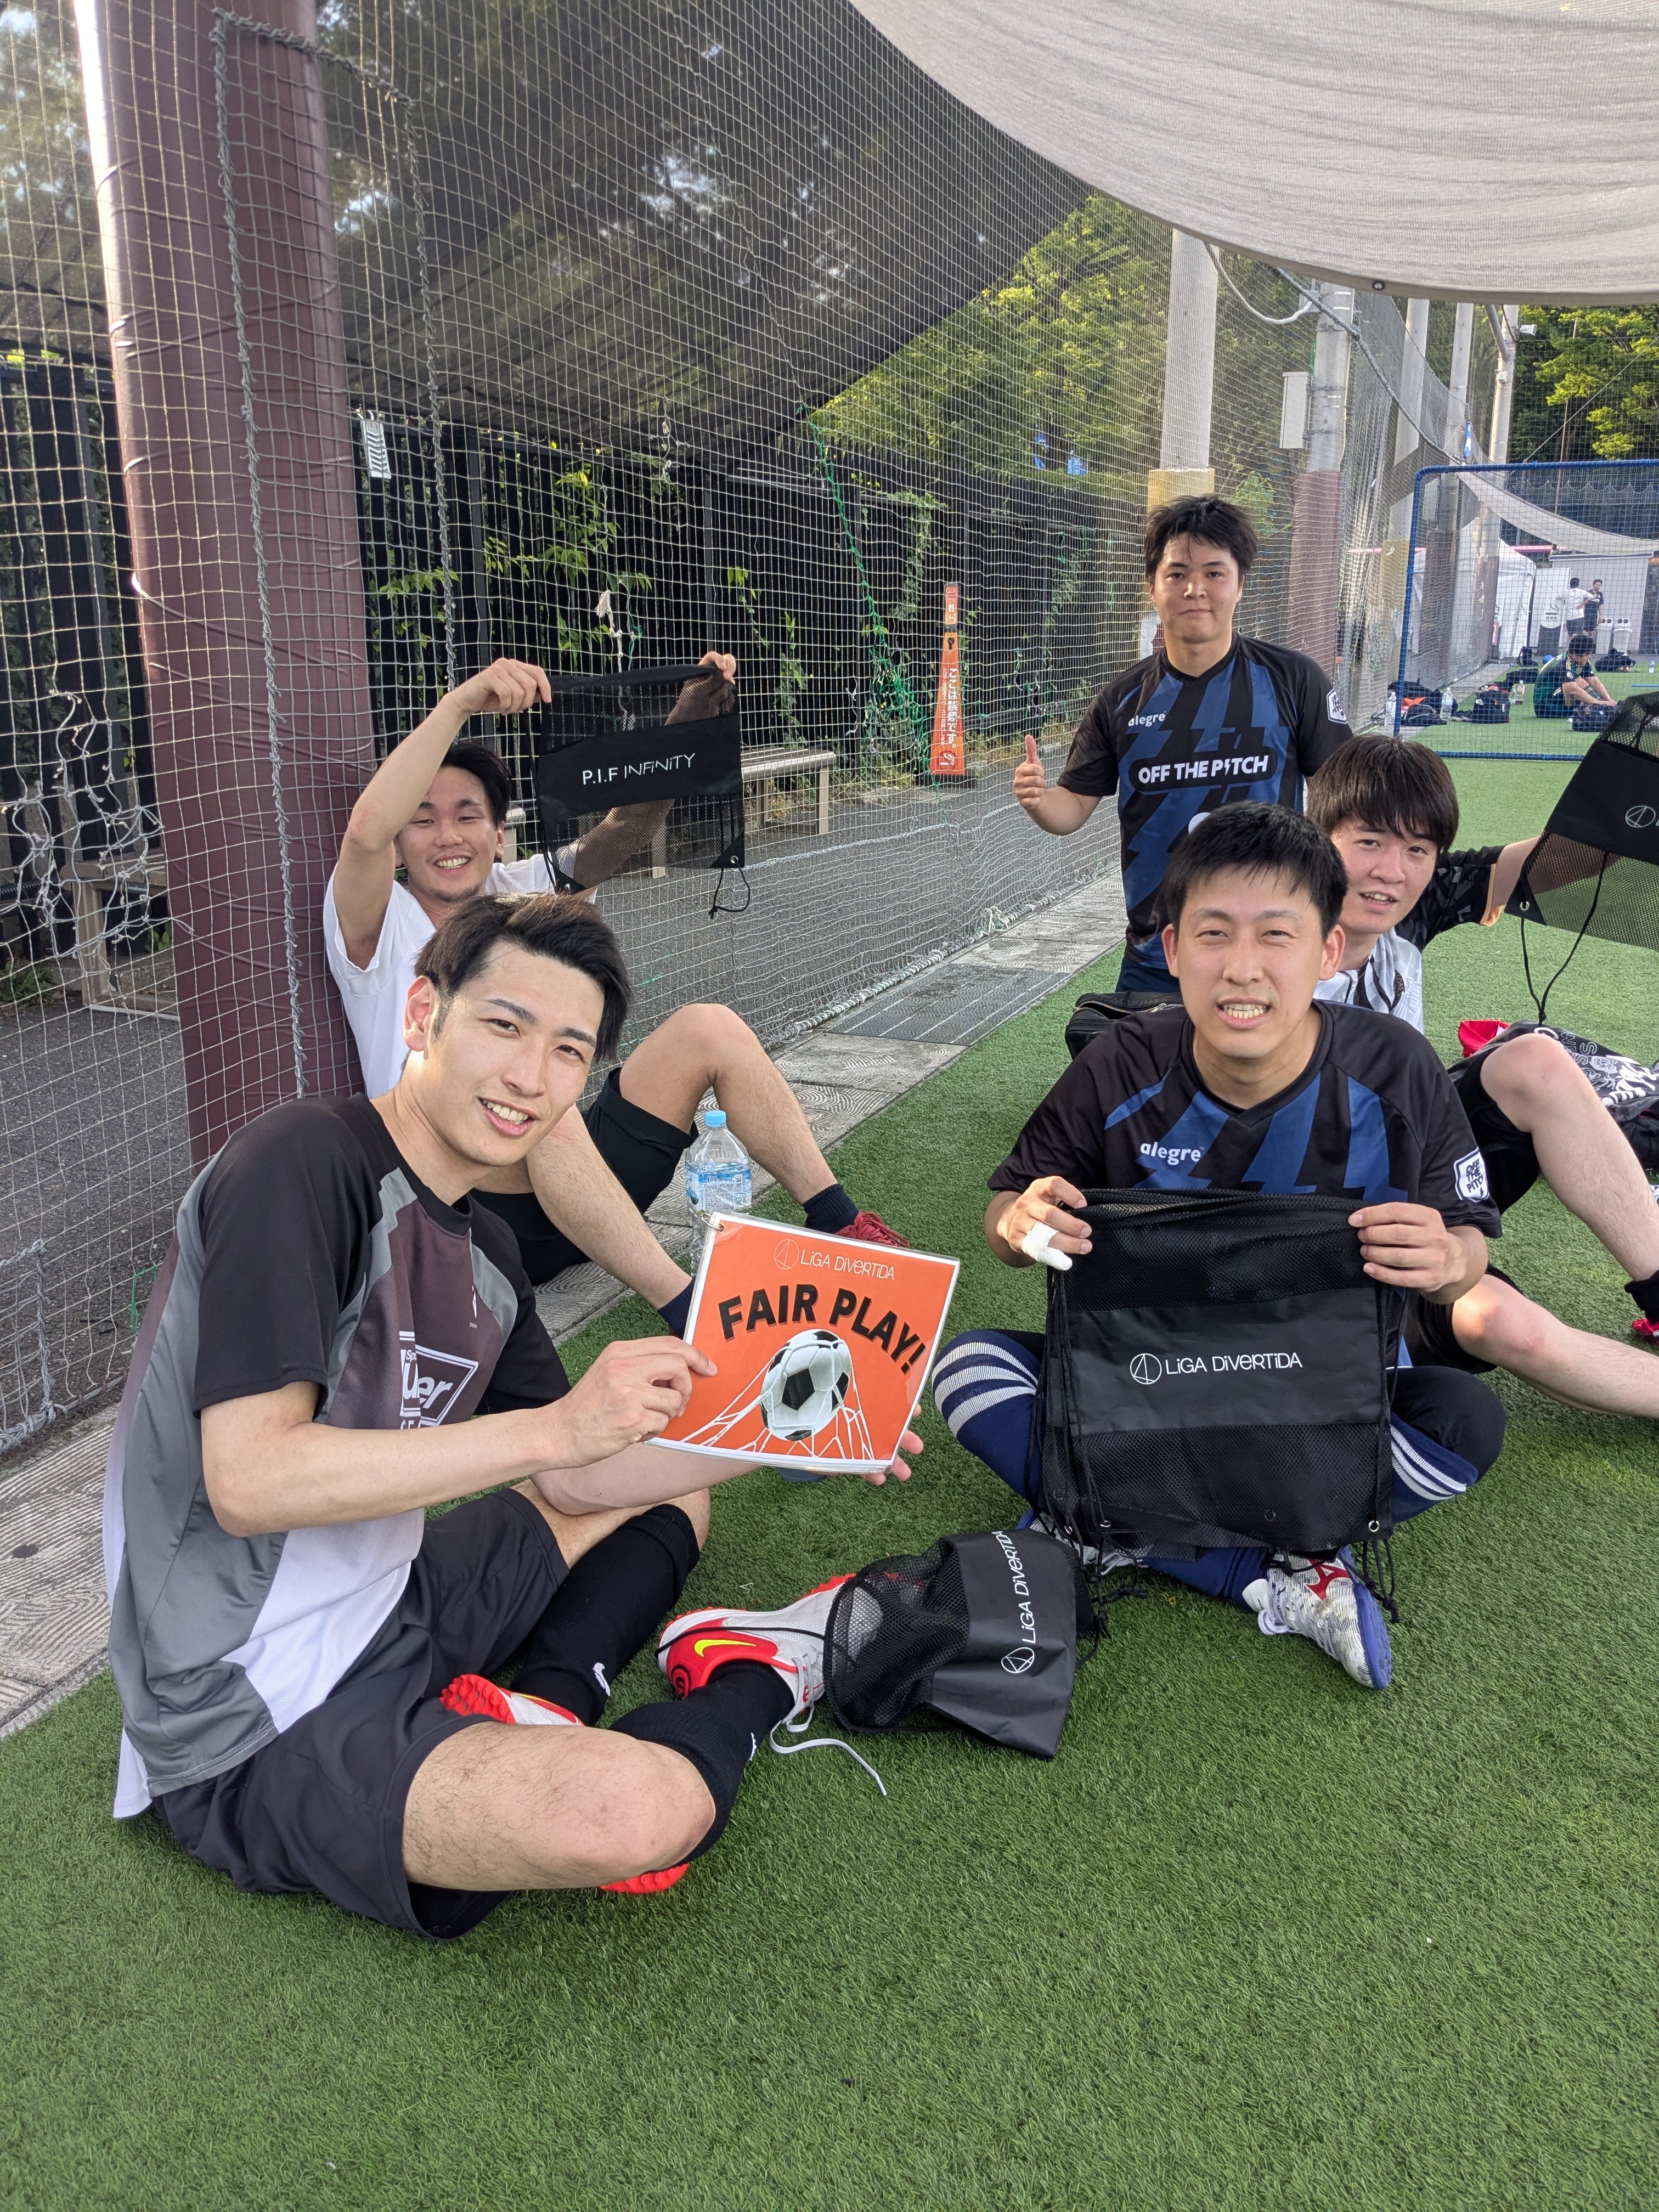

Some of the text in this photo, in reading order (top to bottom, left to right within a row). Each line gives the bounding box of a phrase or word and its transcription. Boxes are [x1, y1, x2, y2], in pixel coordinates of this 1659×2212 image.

[947, 668, 958, 748] ここは禁煙です。
[1128, 713, 1165, 727] alegre
[582, 767, 618, 785] P.I.F
[1138, 755, 1269, 784] OFF THE PITCH
[1140, 1141, 1201, 1166] alegre
[1465, 1158, 1480, 1174] OFF
[1465, 1166, 1481, 1183] THE
[718, 1284, 926, 1375] FAIR PLAY!
